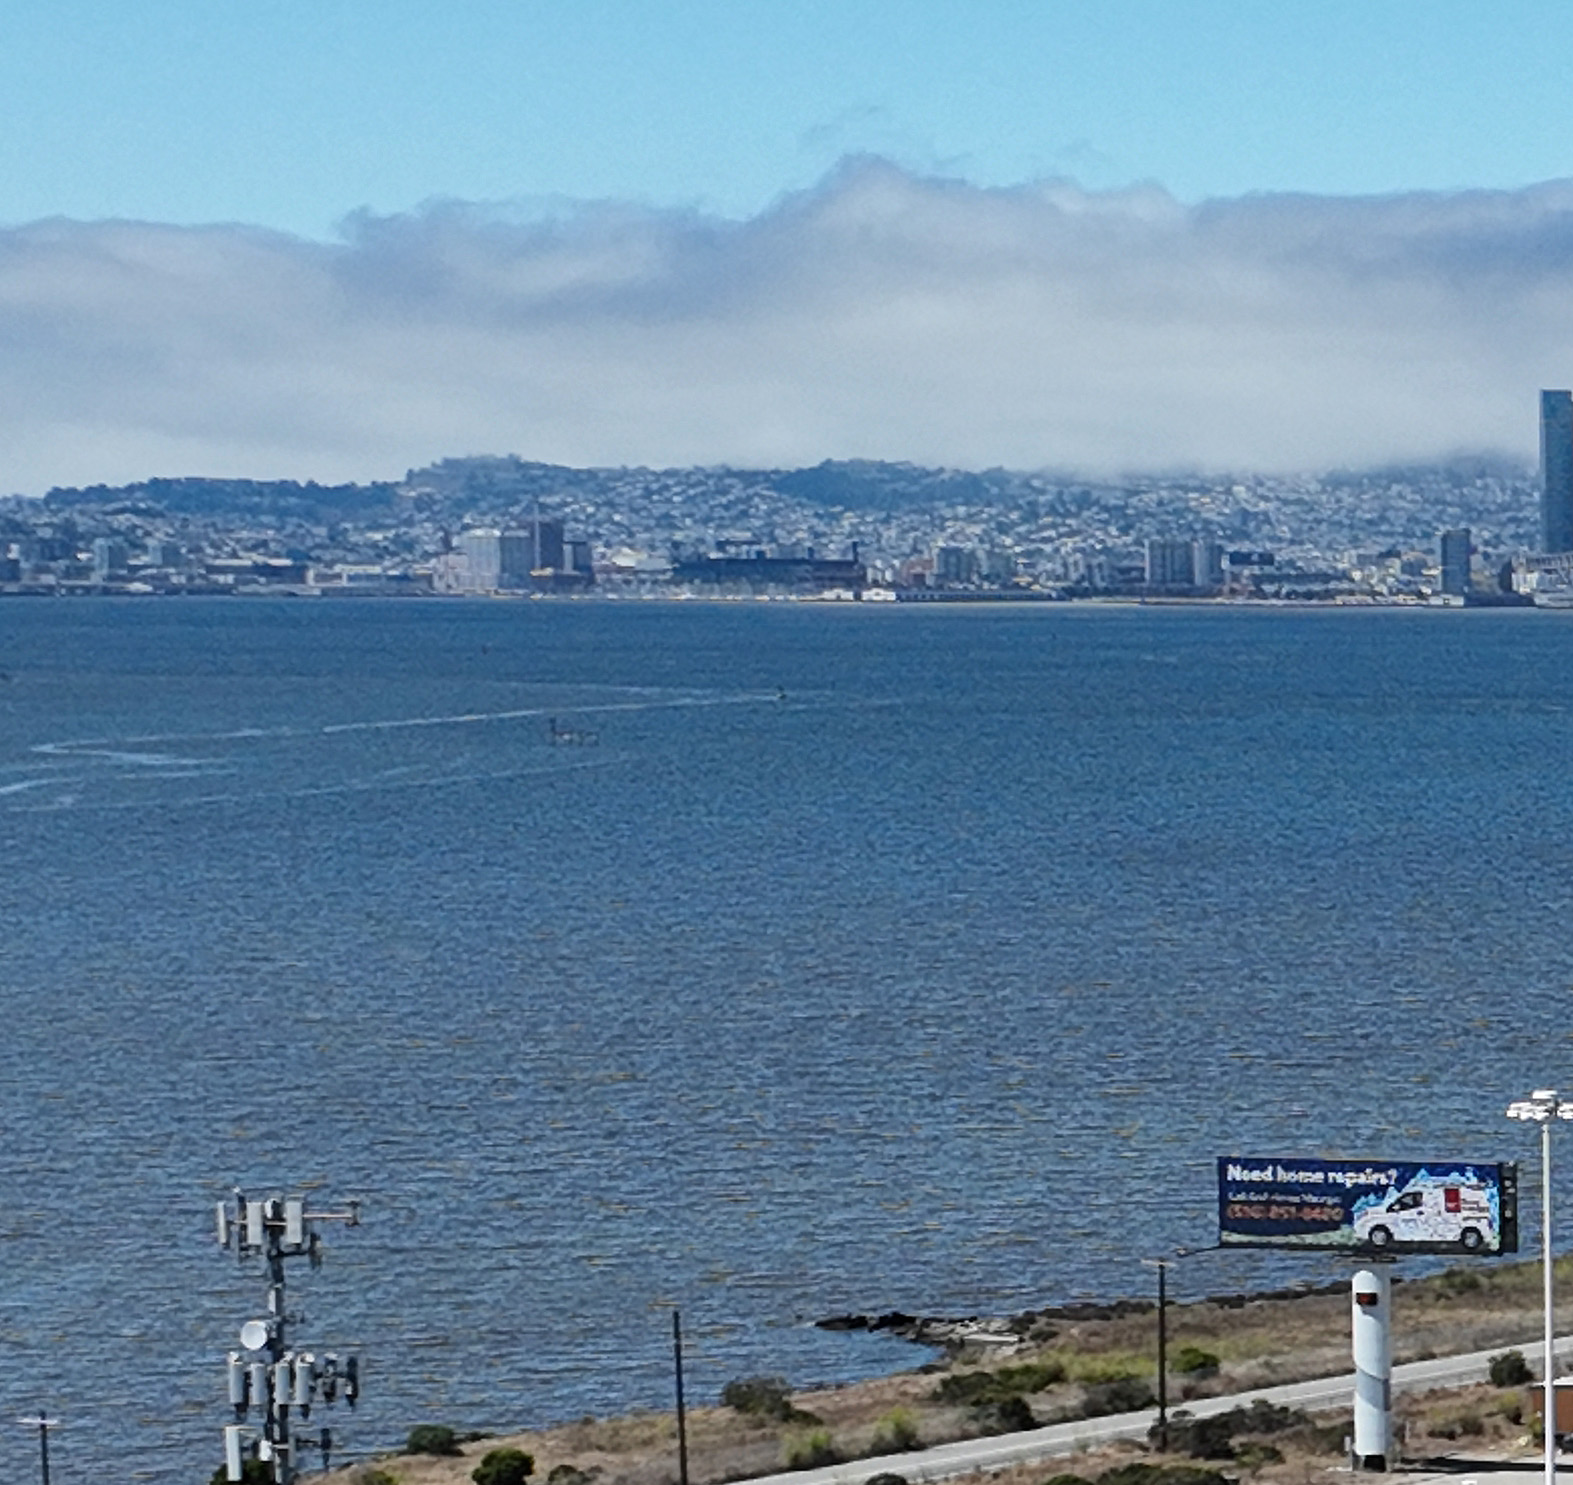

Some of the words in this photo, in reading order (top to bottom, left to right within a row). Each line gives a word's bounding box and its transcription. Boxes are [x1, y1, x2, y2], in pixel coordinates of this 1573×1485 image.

[1227, 1164, 1273, 1181] Need
[1276, 1165, 1324, 1183] home
[1328, 1168, 1397, 1188] repairs?
